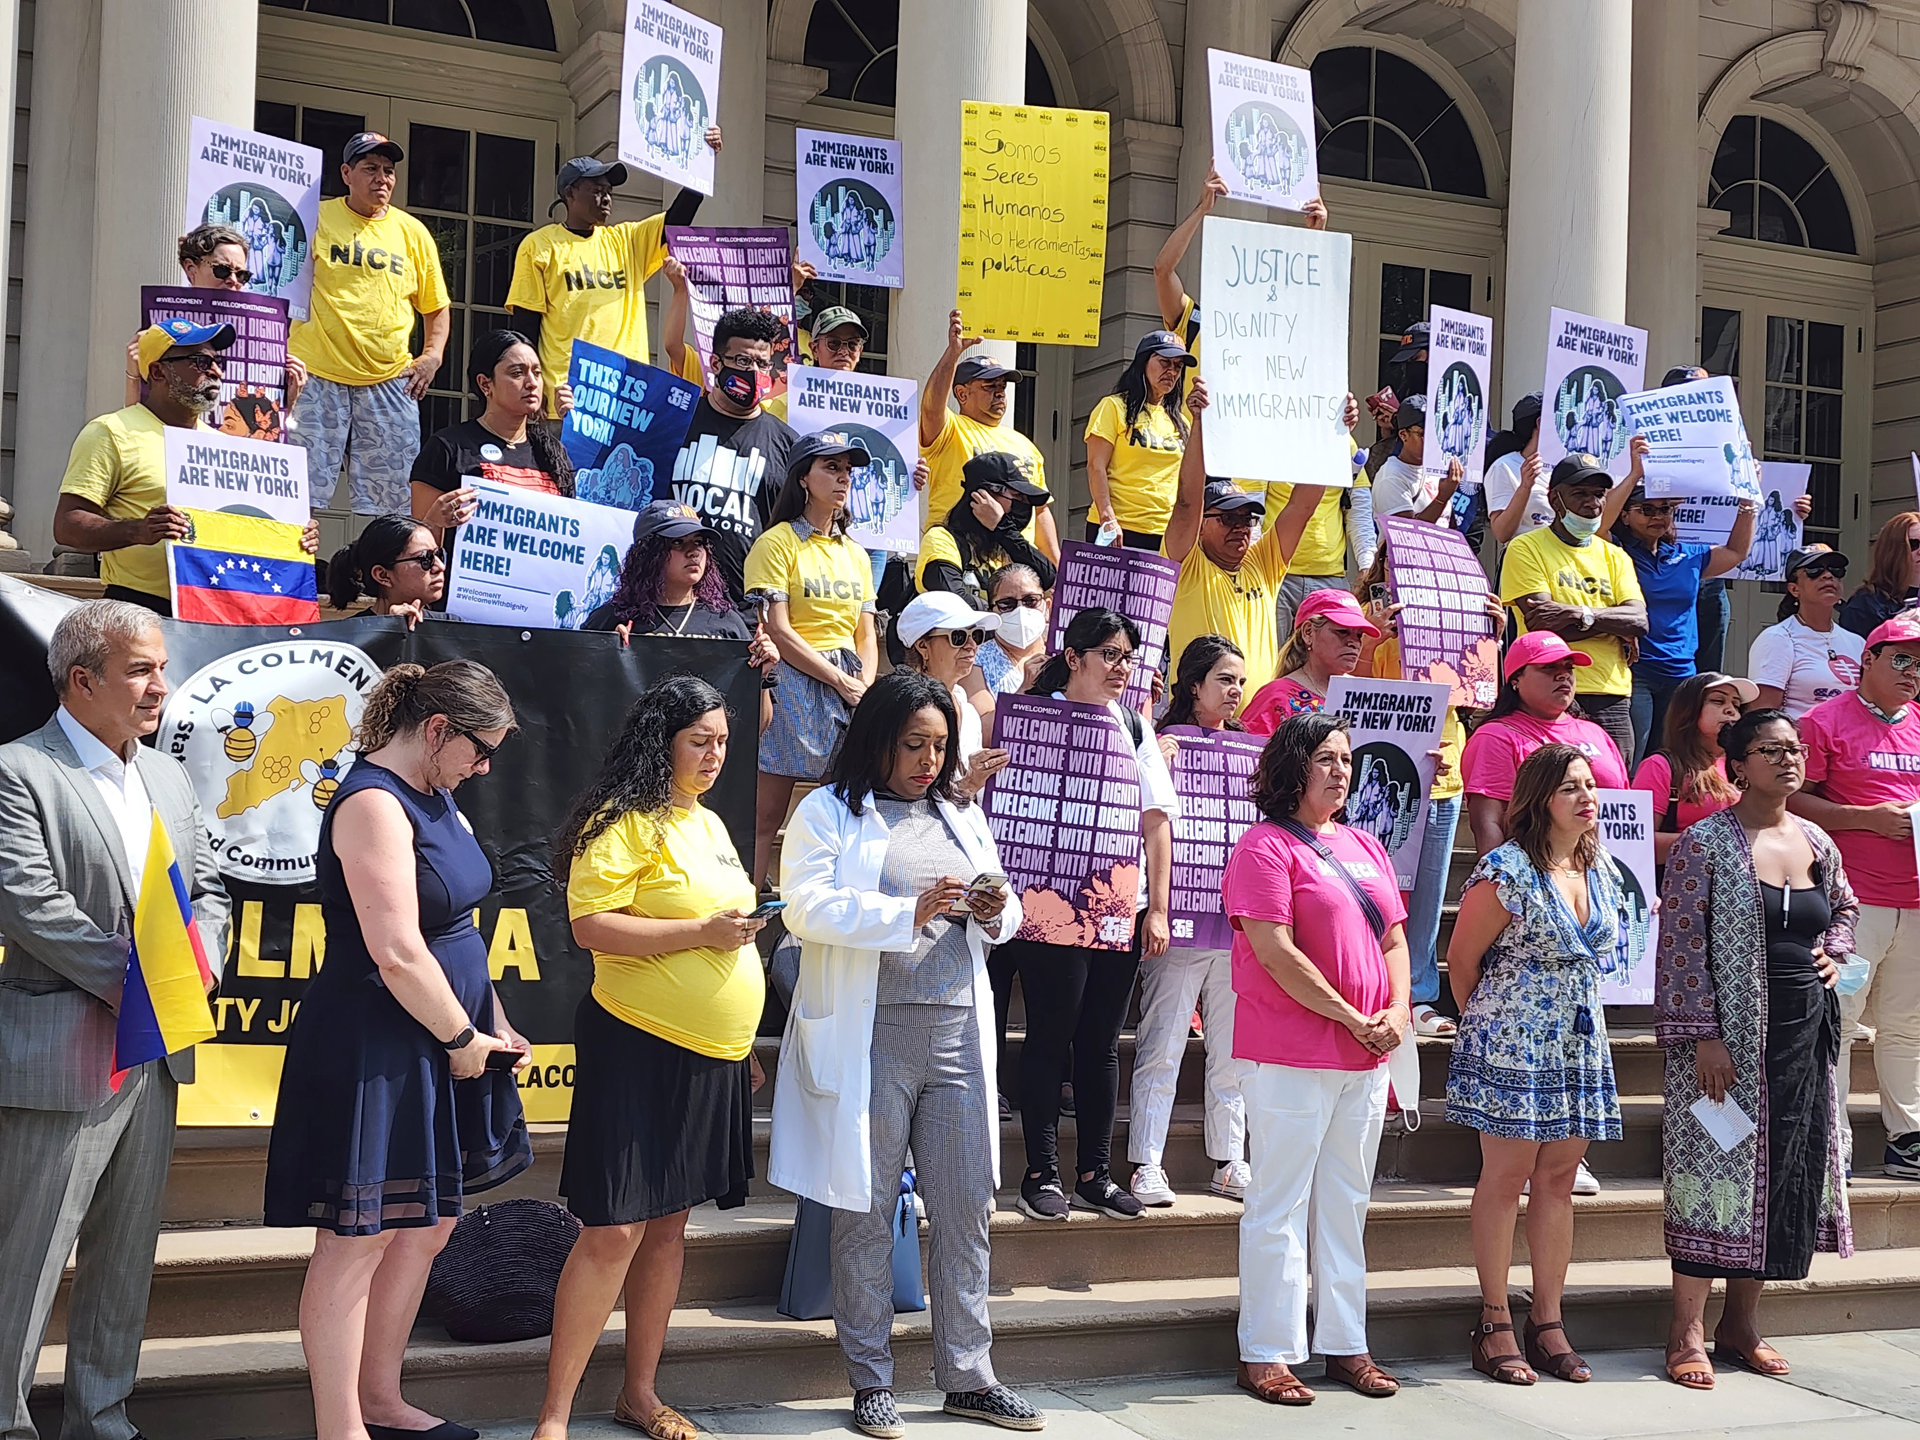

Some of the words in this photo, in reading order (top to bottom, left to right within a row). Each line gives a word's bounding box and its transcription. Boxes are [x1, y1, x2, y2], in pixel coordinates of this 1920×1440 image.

[641, 2, 709, 46] IMMIGRANTS
[634, 16, 654, 38] ARE
[657, 25, 680, 49] NEW
[684, 37, 714, 64] YORK!
[1224, 61, 1297, 87] IMMIGRANTS
[1218, 73, 1240, 88] ARE
[1243, 79, 1268, 94] NEW
[1272, 84, 1305, 102] YORK!
[1014, 111, 1028, 120] NICE
[1065, 115, 1079, 124] NICE
[211, 132, 304, 169] IMMIGRANTS
[812, 140, 887, 160] IMMIGRANTS
[963, 139, 977, 147] NICE
[979, 129, 1061, 164] Somos
[1093, 144, 1107, 152] NICE
[200, 146, 228, 165] ARE
[233, 154, 266, 174] NEW
[270, 161, 312, 187] YORK!
[805, 153, 827, 167] ARE
[830, 155, 856, 170] NEW
[860, 159, 894, 175] YORK!
[963, 169, 977, 178] NICE
[982, 163, 1038, 186] Seres
[962, 202, 976, 210] NICE
[983, 193, 1065, 223] Humanos
[330, 234, 404, 276] NICE
[673, 246, 720, 263] WELCOME
[720, 248, 744, 265] WITH
[747, 248, 787, 265] DIGNITY
[1010, 230, 1092, 260] Herramientas
[565, 258, 626, 292] NICE
[724, 267, 747, 284] WITH
[749, 267, 788, 284] DIGNITY
[1226, 245, 1321, 288] JUSTICE
[884, 275, 900, 285] NYIC
[1267, 284, 1278, 302] &
[725, 286, 749, 303] WITH
[751, 286, 790, 302] DIGNITY
[250, 318, 285, 341] DIGNITY
[1214, 310, 1297, 344] DIGNITY
[1441, 318, 1484, 341] IMMIGRANTS
[1564, 321, 1634, 350] IMMIGRANTS
[248, 340, 285, 363] DIGNITY
[1436, 333, 1449, 348] ARE
[1450, 336, 1466, 351] NEW
[1468, 340, 1487, 357] YORK!
[1556, 335, 1577, 351] ARE
[1580, 341, 1604, 357] NEW
[1607, 347, 1638, 366] YORK!
[248, 362, 284, 385] DIGNITY
[578, 358, 622, 394] THIS
[620, 372, 647, 403] IS
[1266, 356, 1307, 380] NEW
[680, 391, 692, 411] NYIC
[806, 377, 899, 403] IMMIGRANTS
[1626, 390, 1724, 416] IMMIGRANTS
[573, 384, 613, 419] OUR
[612, 400, 655, 433] NEW
[798, 392, 825, 410] ARE
[829, 396, 860, 414] NEW
[866, 401, 908, 420] YORK!
[1216, 392, 1338, 421] IMMIGRANTS
[571, 410, 615, 447] YORK!
[1634, 414, 1662, 430] ARE
[1665, 409, 1733, 425] WELCOME
[186, 445, 289, 477] IMMIGRANTS
[178, 465, 210, 487] ARE
[214, 470, 249, 492] NEW
[254, 475, 298, 499] YORK!
[672, 483, 754, 525] VOCAL
[1674, 509, 1706, 524] HERE!
[710, 518, 753, 537] YORK
[462, 524, 498, 547] ARE
[503, 531, 586, 565] WELCOME
[896, 538, 914, 550] NYIC
[1076, 551, 1121, 563] #WELCOMENY
[460, 549, 511, 576] HERE!
[1392, 547, 1433, 568] WELCOME
[804, 569, 862, 600] NICE
[1066, 562, 1127, 590] WELCOME
[1128, 572, 1156, 595] WITH
[1394, 568, 1437, 587] WELCOME
[1436, 571, 1458, 590] WITH
[1457, 574, 1488, 594] DIGNITY
[1558, 570, 1613, 597] NICE
[457, 586, 501, 599] #WelcomeNY
[1062, 585, 1123, 612] WELCOME
[1125, 595, 1152, 618] WITH
[1397, 587, 1440, 607] WELCOME
[1439, 591, 1461, 610] WITH
[1400, 608, 1441, 628] WELCOME
[1441, 612, 1462, 631] WITH
[1463, 614, 1493, 634] DIGNITY
[1403, 628, 1441, 648] WELCOME
[1442, 631, 1462, 650] WITH
[190, 675, 233, 704] LA
[1343, 691, 1432, 714] IMMIGRANTS
[1012, 704, 1062, 715] #WELCOMENY
[1361, 712, 1392, 730] NEW
[1396, 714, 1436, 733] YORK!
[1003, 716, 1069, 746] WELCOME
[1072, 724, 1103, 750] WITH
[999, 741, 1066, 771] WELCOME
[1069, 750, 1101, 776] WITH
[1104, 755, 1138, 782] DIGNITY
[1173, 749, 1225, 772] WELCOME
[1226, 754, 1254, 775] WITH
[996, 767, 1062, 796] WELCOME
[1066, 776, 1100, 800] WITH
[1102, 780, 1139, 806] DIGNITY
[1174, 771, 1226, 796] WELCOME
[991, 791, 1059, 822] WELCOME
[1061, 801, 1096, 826] WITH
[1098, 806, 1140, 832] DIGNITY
[1228, 800, 1256, 821] WITH
[988, 817, 1056, 848] WELCOME
[1057, 826, 1092, 852] WITH
[1095, 831, 1140, 857] DIGNITY
[1172, 820, 1226, 843] WELCOME
[1604, 822, 1644, 840] YORK!
[998, 843, 1051, 873] ELCOME
[1054, 851, 1088, 877] WITH
[1172, 842, 1225, 866] WELCOME
[1171, 866, 1223, 890] WELCOME
[1171, 890, 1222, 913] WELCOME
[1101, 916, 1121, 942] 35
[1119, 917, 1132, 943] NYIC
[1171, 919, 1186, 938] 35
